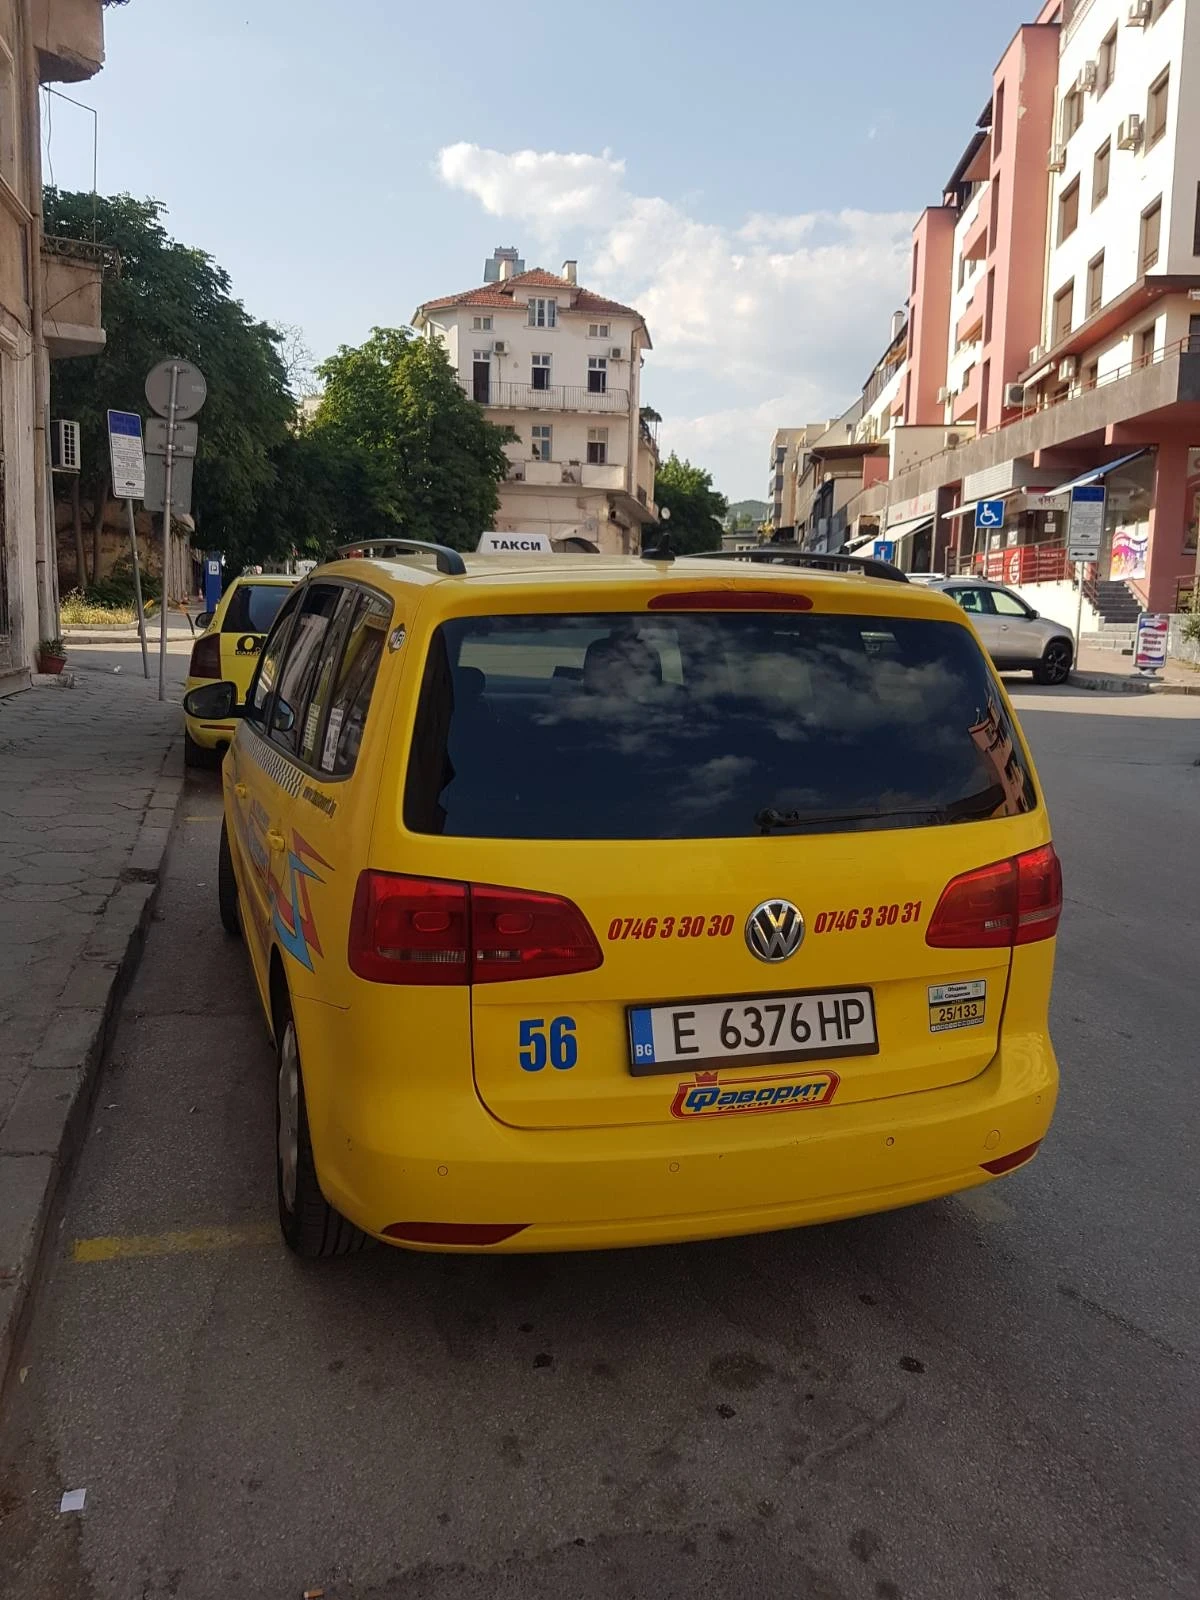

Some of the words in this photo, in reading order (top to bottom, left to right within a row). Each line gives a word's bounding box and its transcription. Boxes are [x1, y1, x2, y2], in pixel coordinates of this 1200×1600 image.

[490, 539, 541, 551] ТАКСИ
[607, 916, 658, 941] 0746
[660, 916, 676, 939] 3
[677, 915, 706, 938] 30
[707, 914, 735, 937] 30
[814, 909, 859, 934] 0746
[860, 907, 874, 928] 3
[875, 904, 899, 926] 30
[901, 901, 922, 924] 31
[939, 1003, 978, 1022] 25/133
[672, 1011, 700, 1055] E
[720, 1002, 812, 1050] 6376
[818, 998, 865, 1042] HP
[518, 1015, 578, 1072] 56
[635, 1043, 653, 1057] BG
[685, 1082, 828, 1113] Фаворит
[716, 1100, 769, 1111] ТАКСИ
